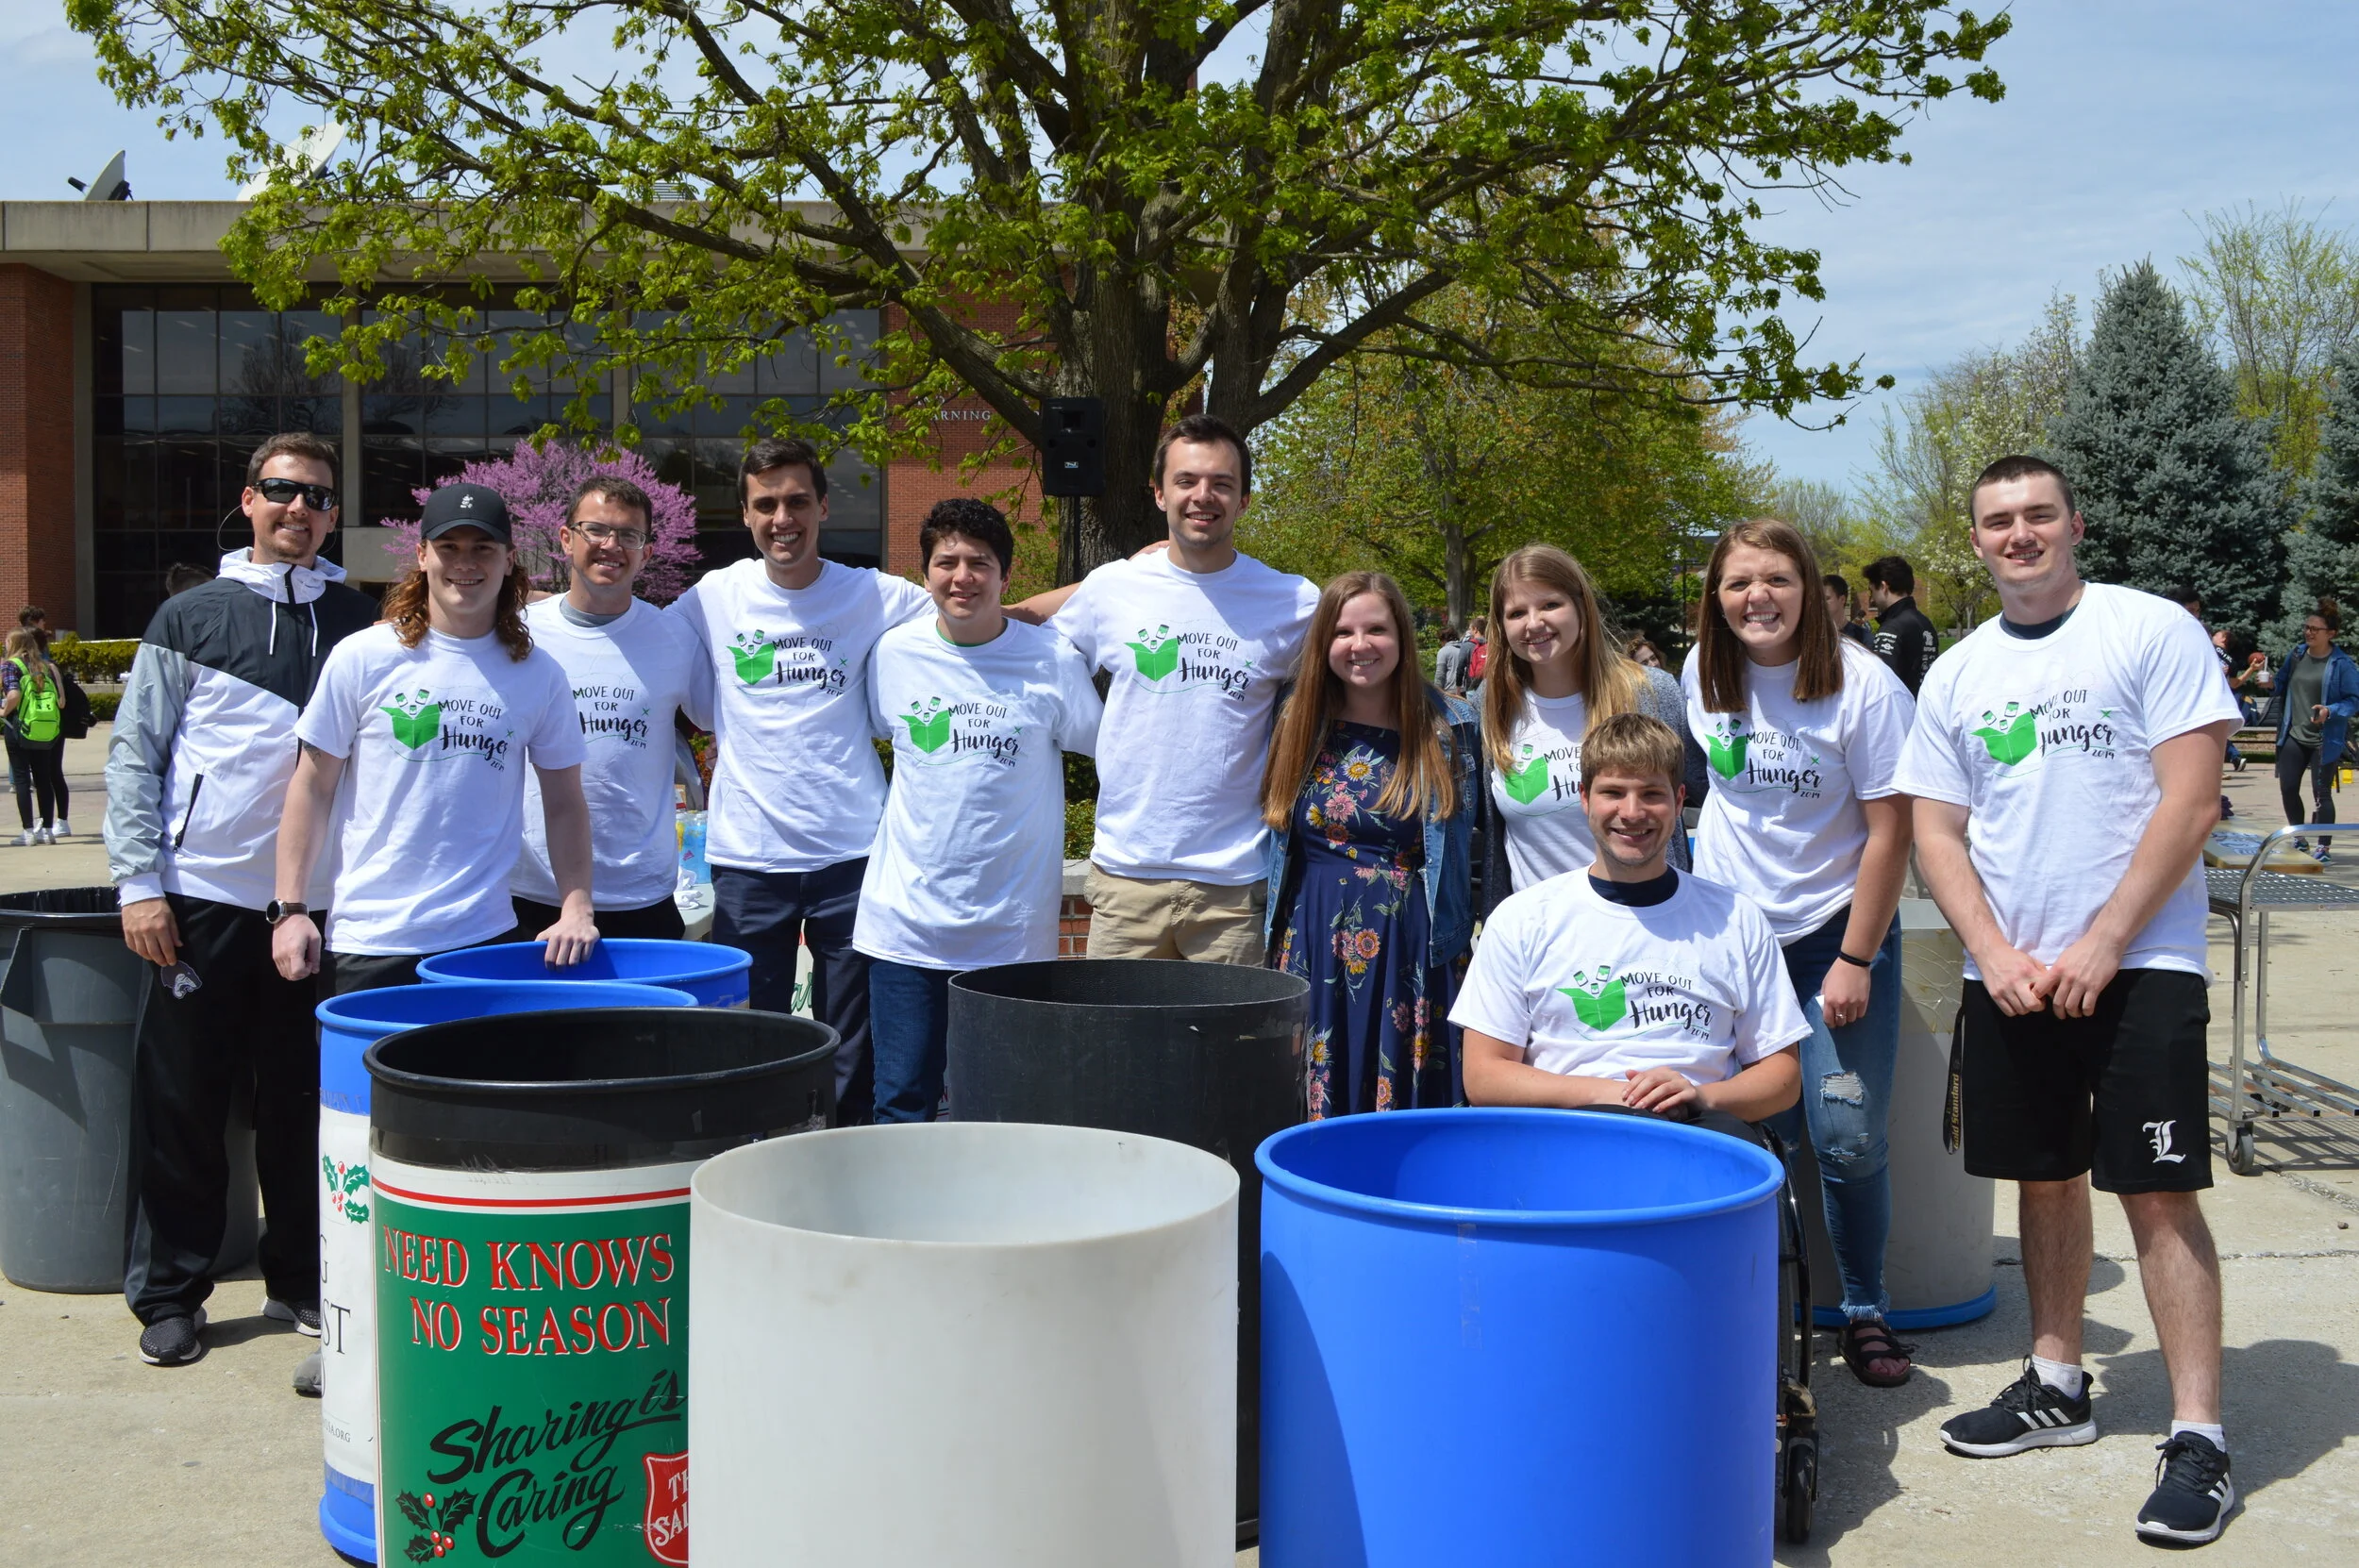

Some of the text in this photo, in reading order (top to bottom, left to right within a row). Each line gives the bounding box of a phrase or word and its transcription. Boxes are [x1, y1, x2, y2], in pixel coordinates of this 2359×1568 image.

[930, 409, 991, 421] ARNING
[772, 637, 832, 652] MOVE OUT
[1177, 632, 1238, 651] MOVE OUT
[793, 651, 815, 661] FOR
[1197, 648, 1221, 660] FOR
[774, 660, 848, 690] Hunger
[1179, 657, 1252, 691] Hunger
[572, 686, 635, 701] MOVE OUT
[2063, 689, 2087, 704] OUT
[438, 699, 502, 720] MOVE OUT
[594, 701, 618, 711] FOR
[948, 702, 1008, 719] MOVE OUT
[460, 715, 484, 728] FOR
[578, 710, 650, 742] Hunger
[968, 718, 991, 728] FOR
[950, 728, 1021, 759] Hunger
[1746, 731, 1799, 751] MOVE OUT
[1763, 748, 1784, 761] FOR
[2091, 749, 2115, 760] 2019
[1747, 757, 1824, 793] Hunger
[1800, 791, 1820, 799] 2019
[1620, 971, 1692, 991] MOVE OUT
[1647, 985, 1675, 998] FOR
[1630, 1000, 1714, 1030] Hunger
[1691, 1026, 1710, 1041] 2019
[2142, 1120, 2186, 1163] L
[382, 1224, 469, 1288] NEED
[485, 1232, 675, 1292] KNOWS
[322, 1298, 351, 1355] ST
[410, 1295, 672, 1357] NO SEASON
[427, 1369, 688, 1485] Sharing is
[476, 1465, 626, 1559] Caring
